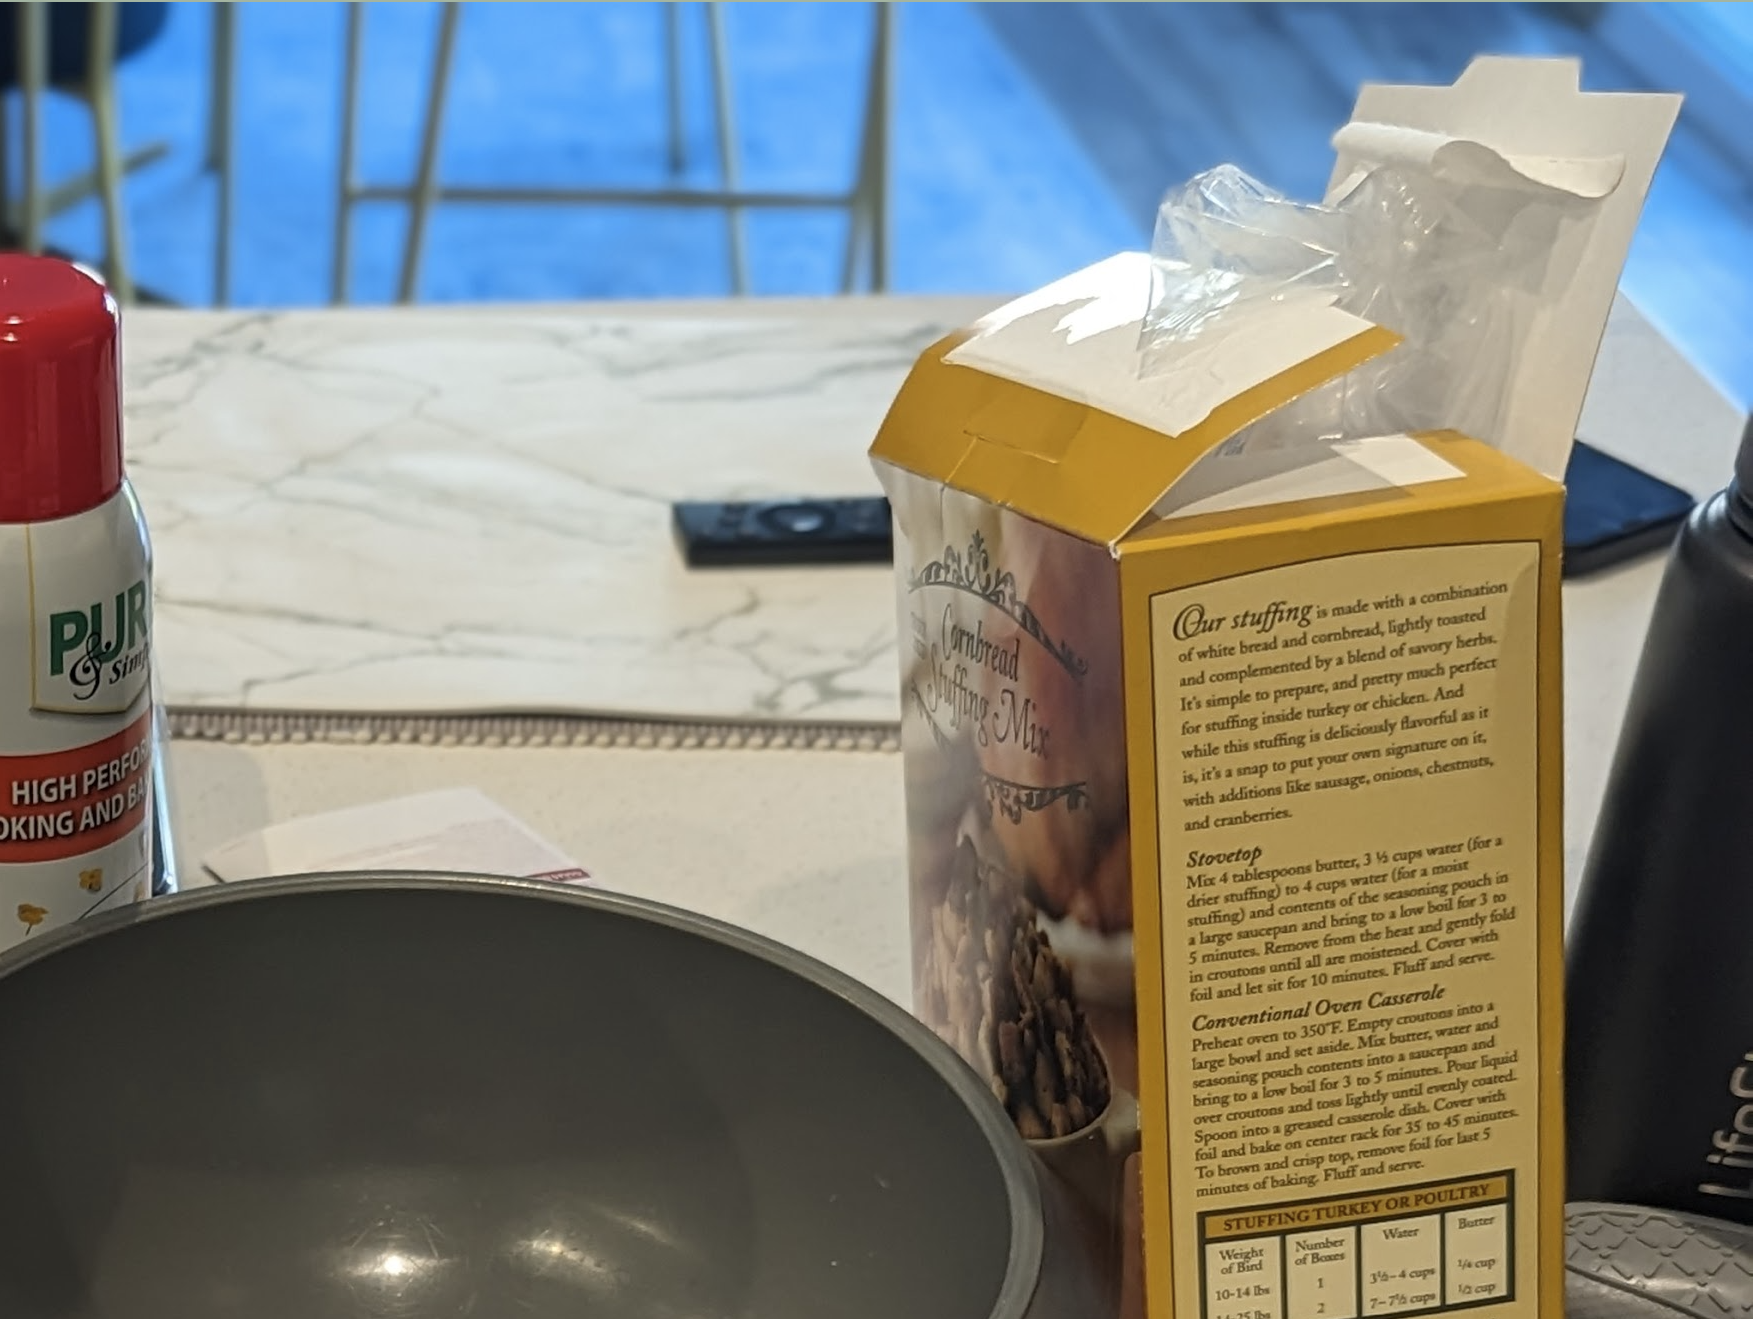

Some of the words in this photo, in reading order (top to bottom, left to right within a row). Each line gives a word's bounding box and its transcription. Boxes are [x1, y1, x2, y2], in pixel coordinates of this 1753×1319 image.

[1172, 604, 1222, 641] Our
[1230, 605, 1310, 633] stuffing
[1331, 599, 1369, 616] made
[1372, 593, 1404, 610] with
[1420, 582, 1508, 604] combination
[942, 602, 1020, 682] Cornbread
[1177, 646, 1193, 663] of
[1195, 643, 1236, 659] white
[1239, 635, 1278, 654] bread
[1281, 631, 1308, 649] and
[1310, 622, 1386, 644] cornbread,
[1387, 616, 1433, 637] lightly
[1436, 608, 1486, 627] toasted
[69, 632, 111, 700] &
[1179, 670, 1206, 687] and
[1208, 656, 1312, 683] complemented
[1314, 654, 1333, 672] by
[1347, 645, 1386, 664] blend
[1389, 642, 1405, 658] of
[1408, 640, 1453, 656] savory
[1455, 632, 1497, 649] herbs.
[928, 642, 989, 747] Stuffing
[993, 688, 1049, 759] Mix
[1180, 695, 1202, 712] It's
[1205, 689, 1252, 710] simple
[1254, 690, 1270, 701] to
[1273, 683, 1329, 703] prepare,
[1331, 673, 1358, 691] and
[1361, 672, 1404, 691] pretty
[1405, 662, 1445, 680] much
[1448, 657, 1497, 679] perfect
[12, 773, 76, 805] HIGH
[79, 793, 124, 831] AND
[1186, 846, 1262, 868] Stovetop
[1191, 1002, 1311, 1031] Conventional
[1315, 999, 1363, 1016] Oven
[1367, 984, 1446, 1009] Casserole
[1191, 1036, 1244, 1052] Preheat
[1246, 1033, 1279, 1045] oven
[1282, 1030, 1297, 1041] to
[1346, 1017, 1395, 1033] Empty
[1395, 1009, 1454, 1025] croutons
[1456, 1004, 1484, 1016] into
[1223, 1209, 1309, 1231] STUFFING
[1312, 1200, 1382, 1220] TURKEY
[1385, 1196, 1410, 1210] OR
[1414, 1184, 1490, 1206] POULTRY
[1219, 1247, 1264, 1263] Weight
[1295, 1237, 1345, 1252] Number
[1382, 1228, 1419, 1240] Water
[1221, 1263, 1233, 1275] of
[1237, 1259, 1263, 1273] Bird
[1294, 1254, 1308, 1266] of
[1311, 1251, 1345, 1264] Boxes
[1254, 1284, 1270, 1296] lbs
